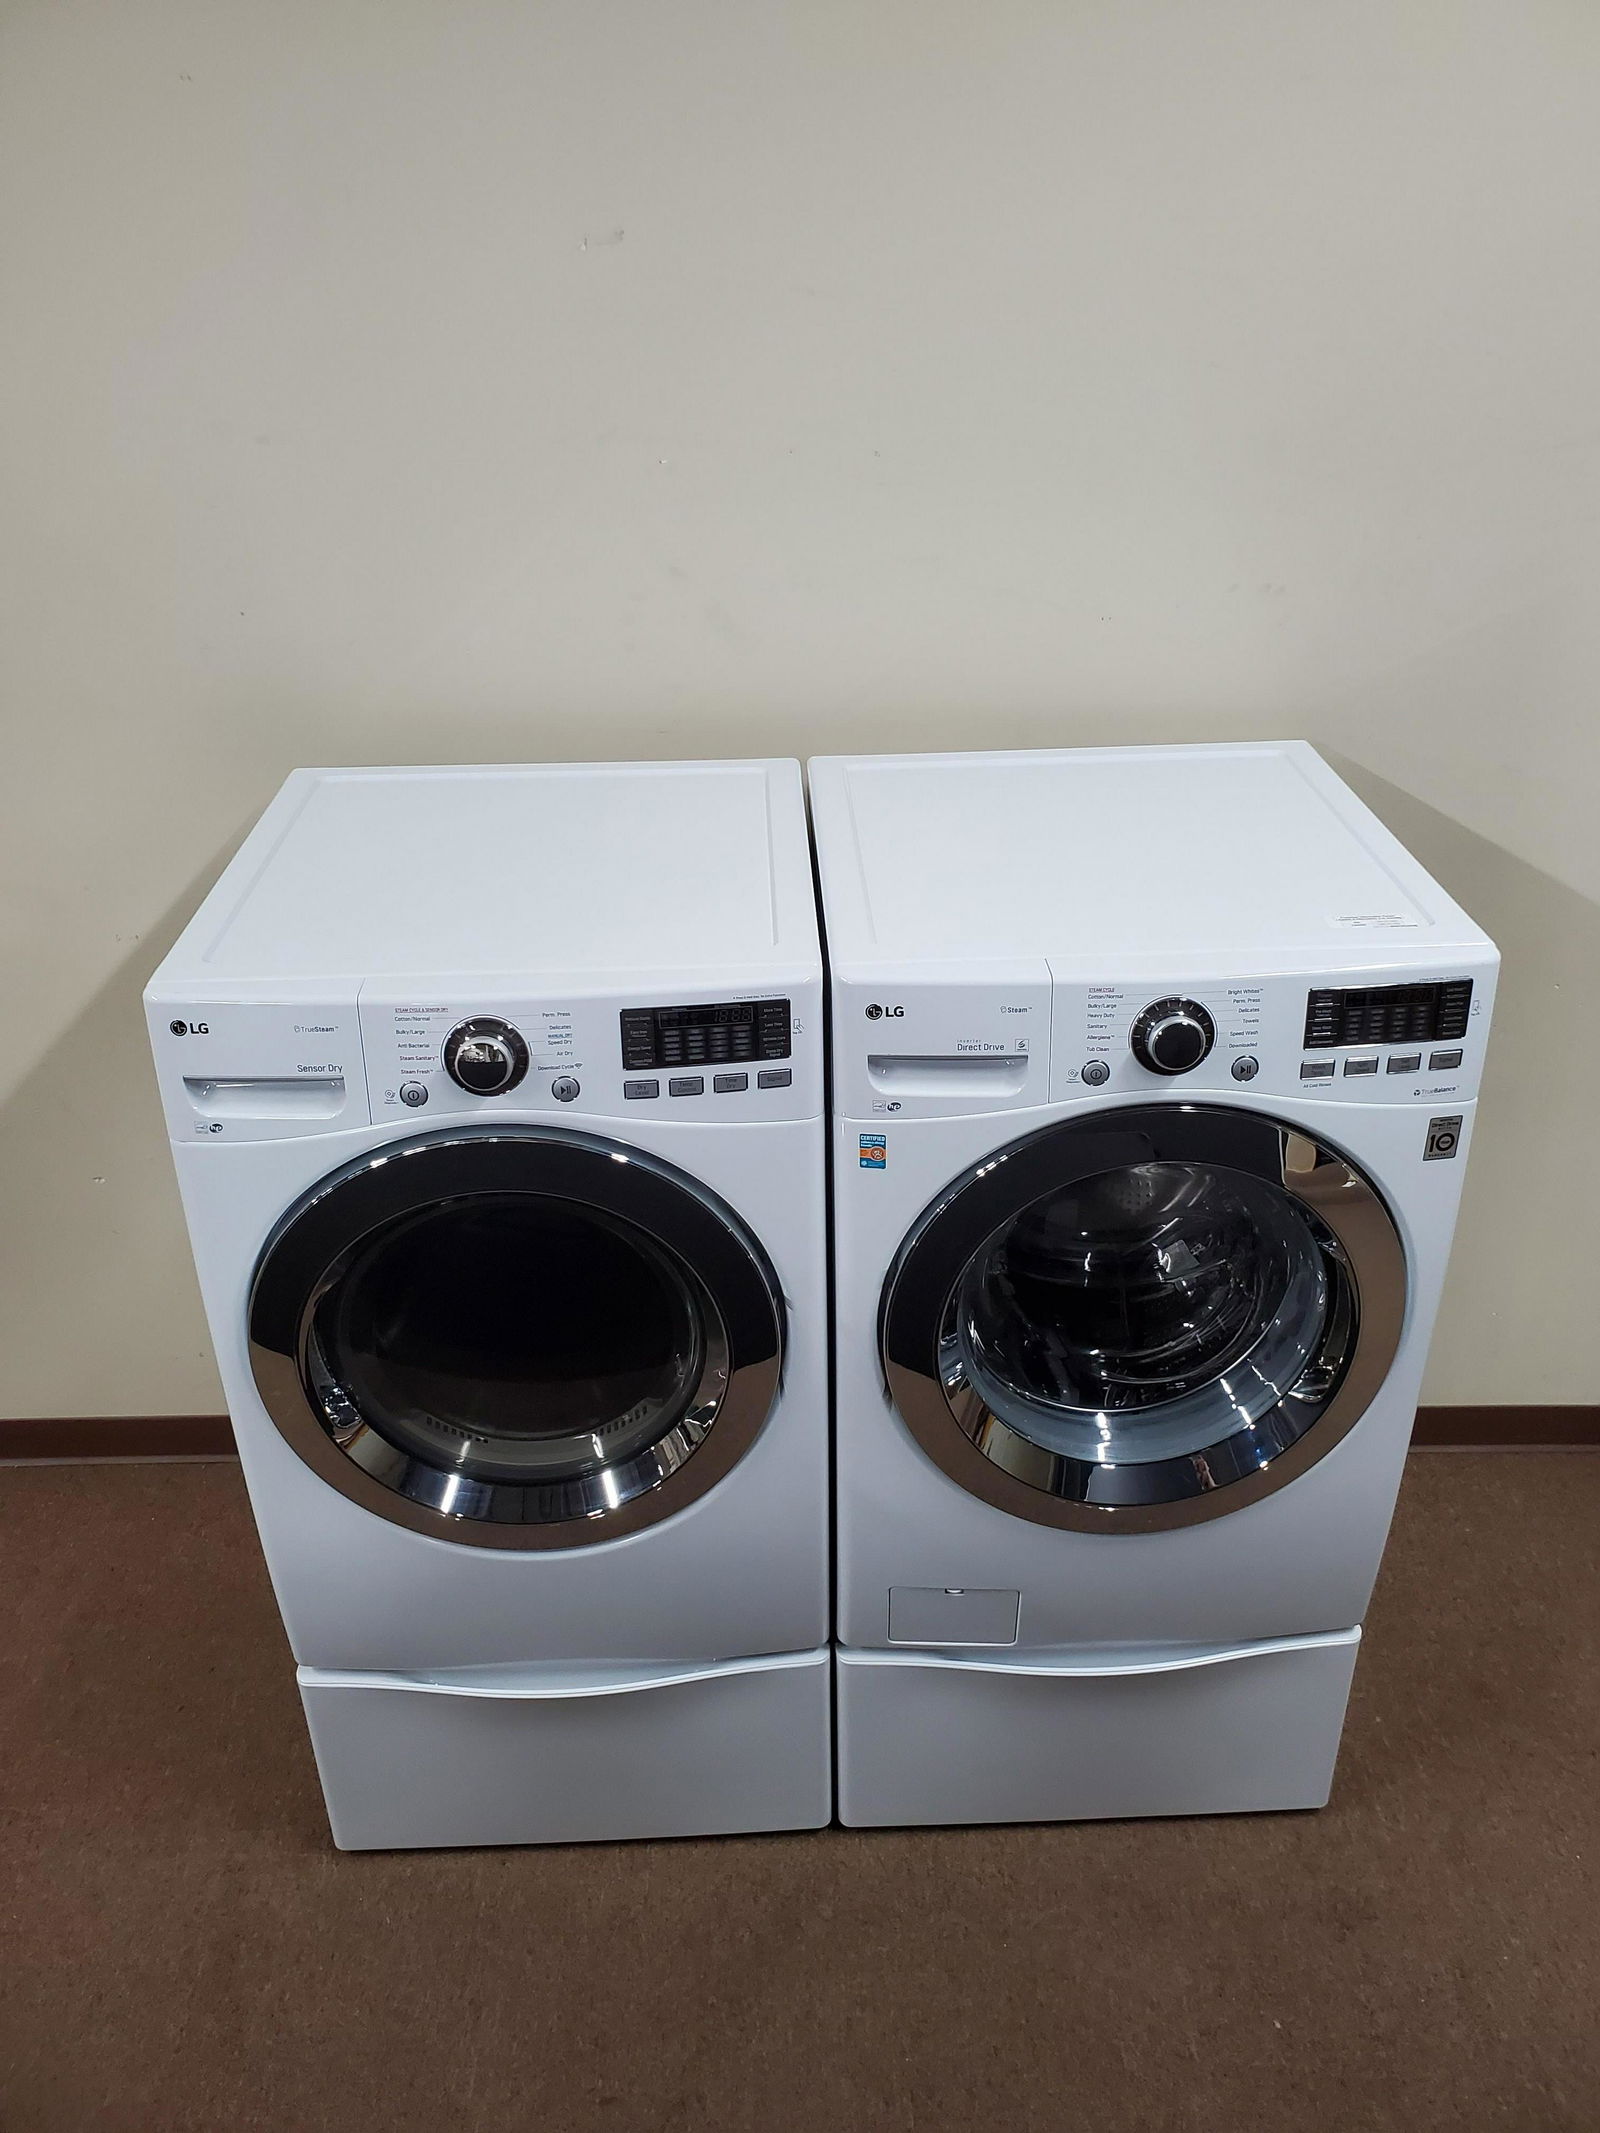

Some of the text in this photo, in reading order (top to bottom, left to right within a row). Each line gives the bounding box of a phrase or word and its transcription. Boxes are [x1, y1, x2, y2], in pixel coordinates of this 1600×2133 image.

[885, 1006, 904, 1017] LG
[190, 1023, 209, 1034] LG
[297, 1063, 343, 1073] Sensor Dry
